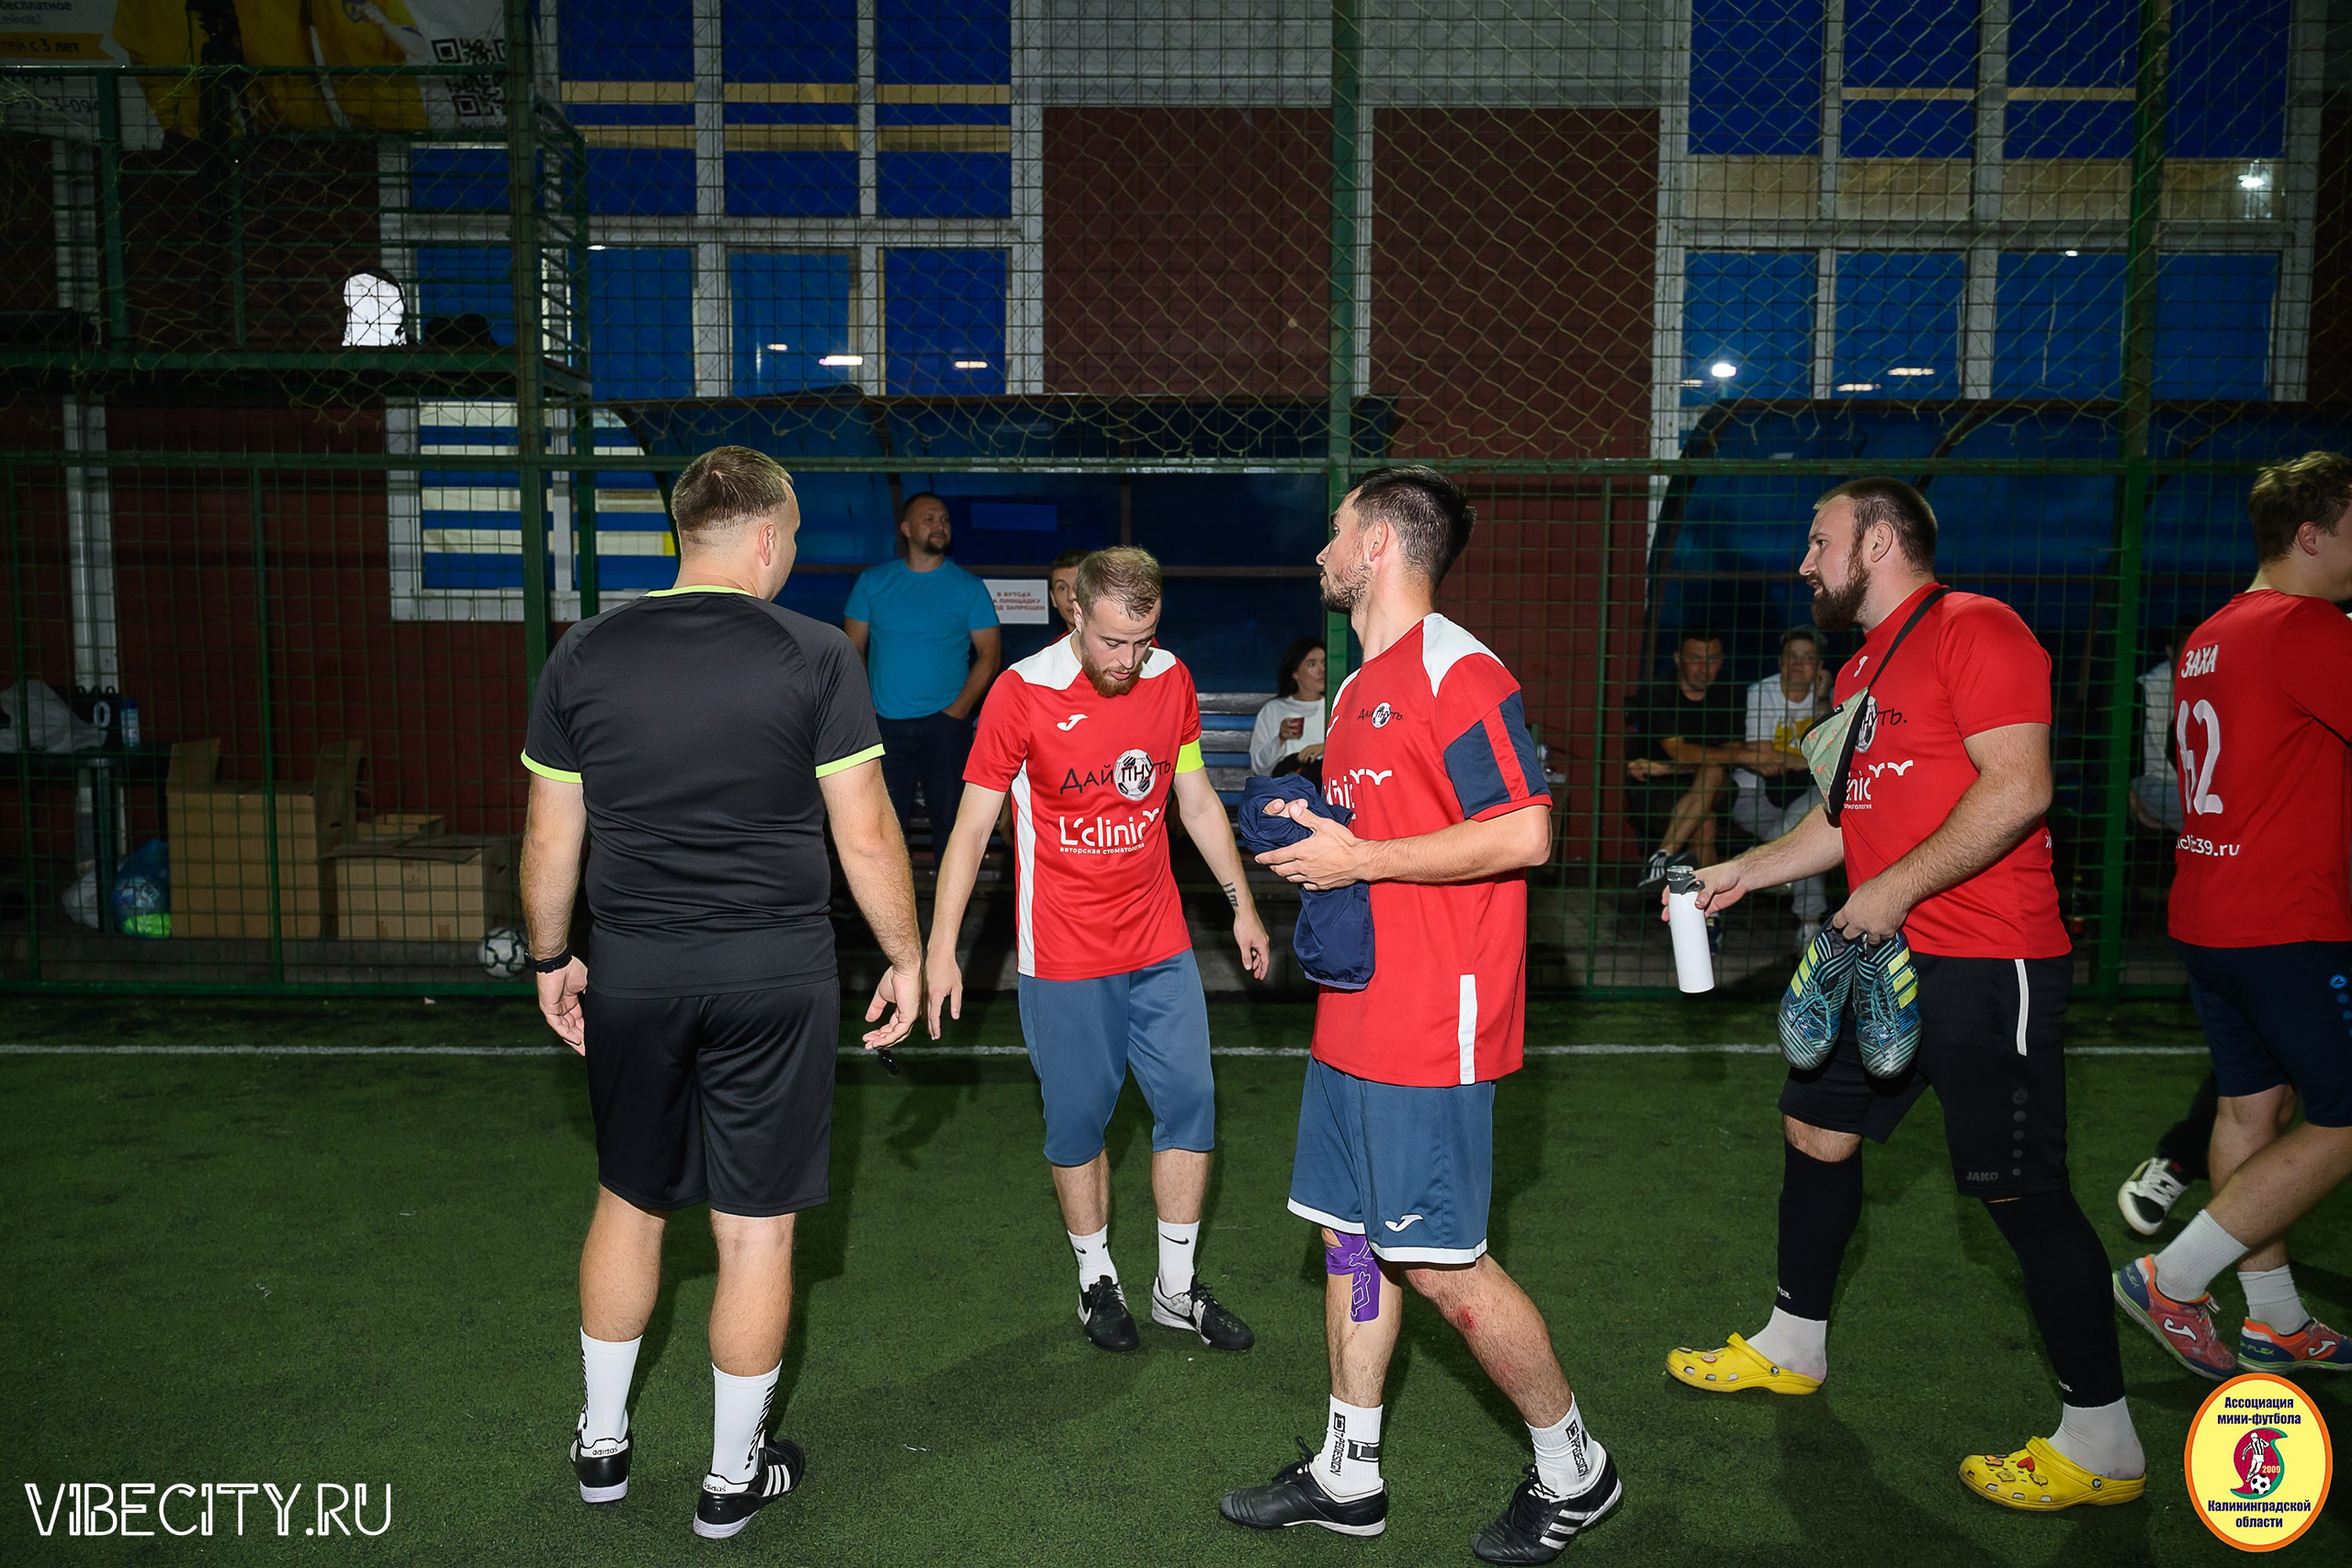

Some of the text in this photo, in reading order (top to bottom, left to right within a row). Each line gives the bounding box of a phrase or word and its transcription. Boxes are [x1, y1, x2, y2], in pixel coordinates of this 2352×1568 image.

[55, 40, 79, 53] лет
[2181, 645, 2218, 678] ЗАХА
[1059, 764, 1114, 795] ДАЙ
[1965, 1171, 1999, 1182] JAKO
